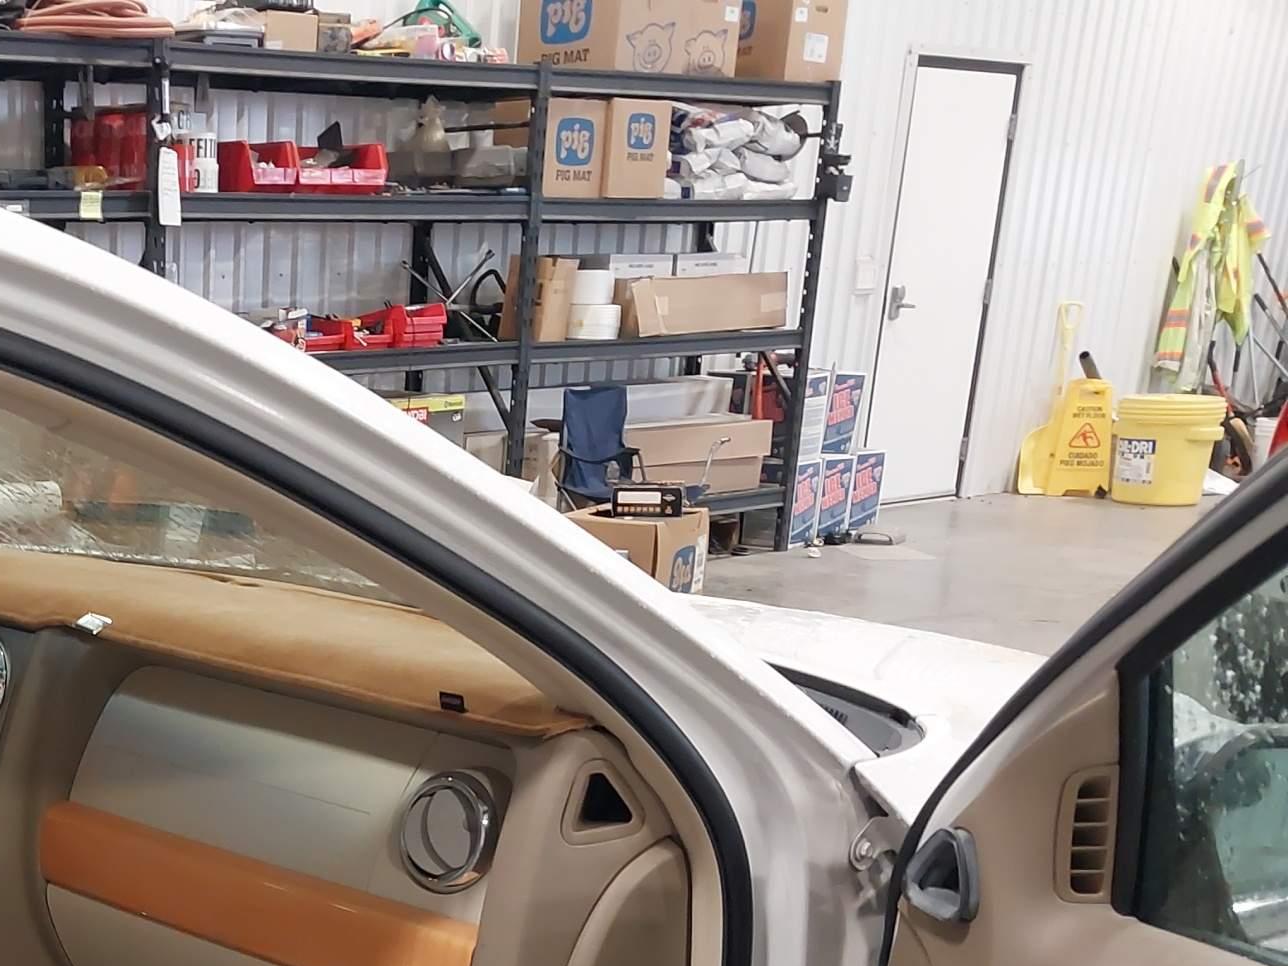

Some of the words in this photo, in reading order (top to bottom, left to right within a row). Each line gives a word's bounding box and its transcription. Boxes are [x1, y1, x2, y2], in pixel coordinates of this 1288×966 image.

[562, 48, 591, 65] MAT
[555, 169, 571, 182] PIG
[572, 169, 593, 182] MAT
